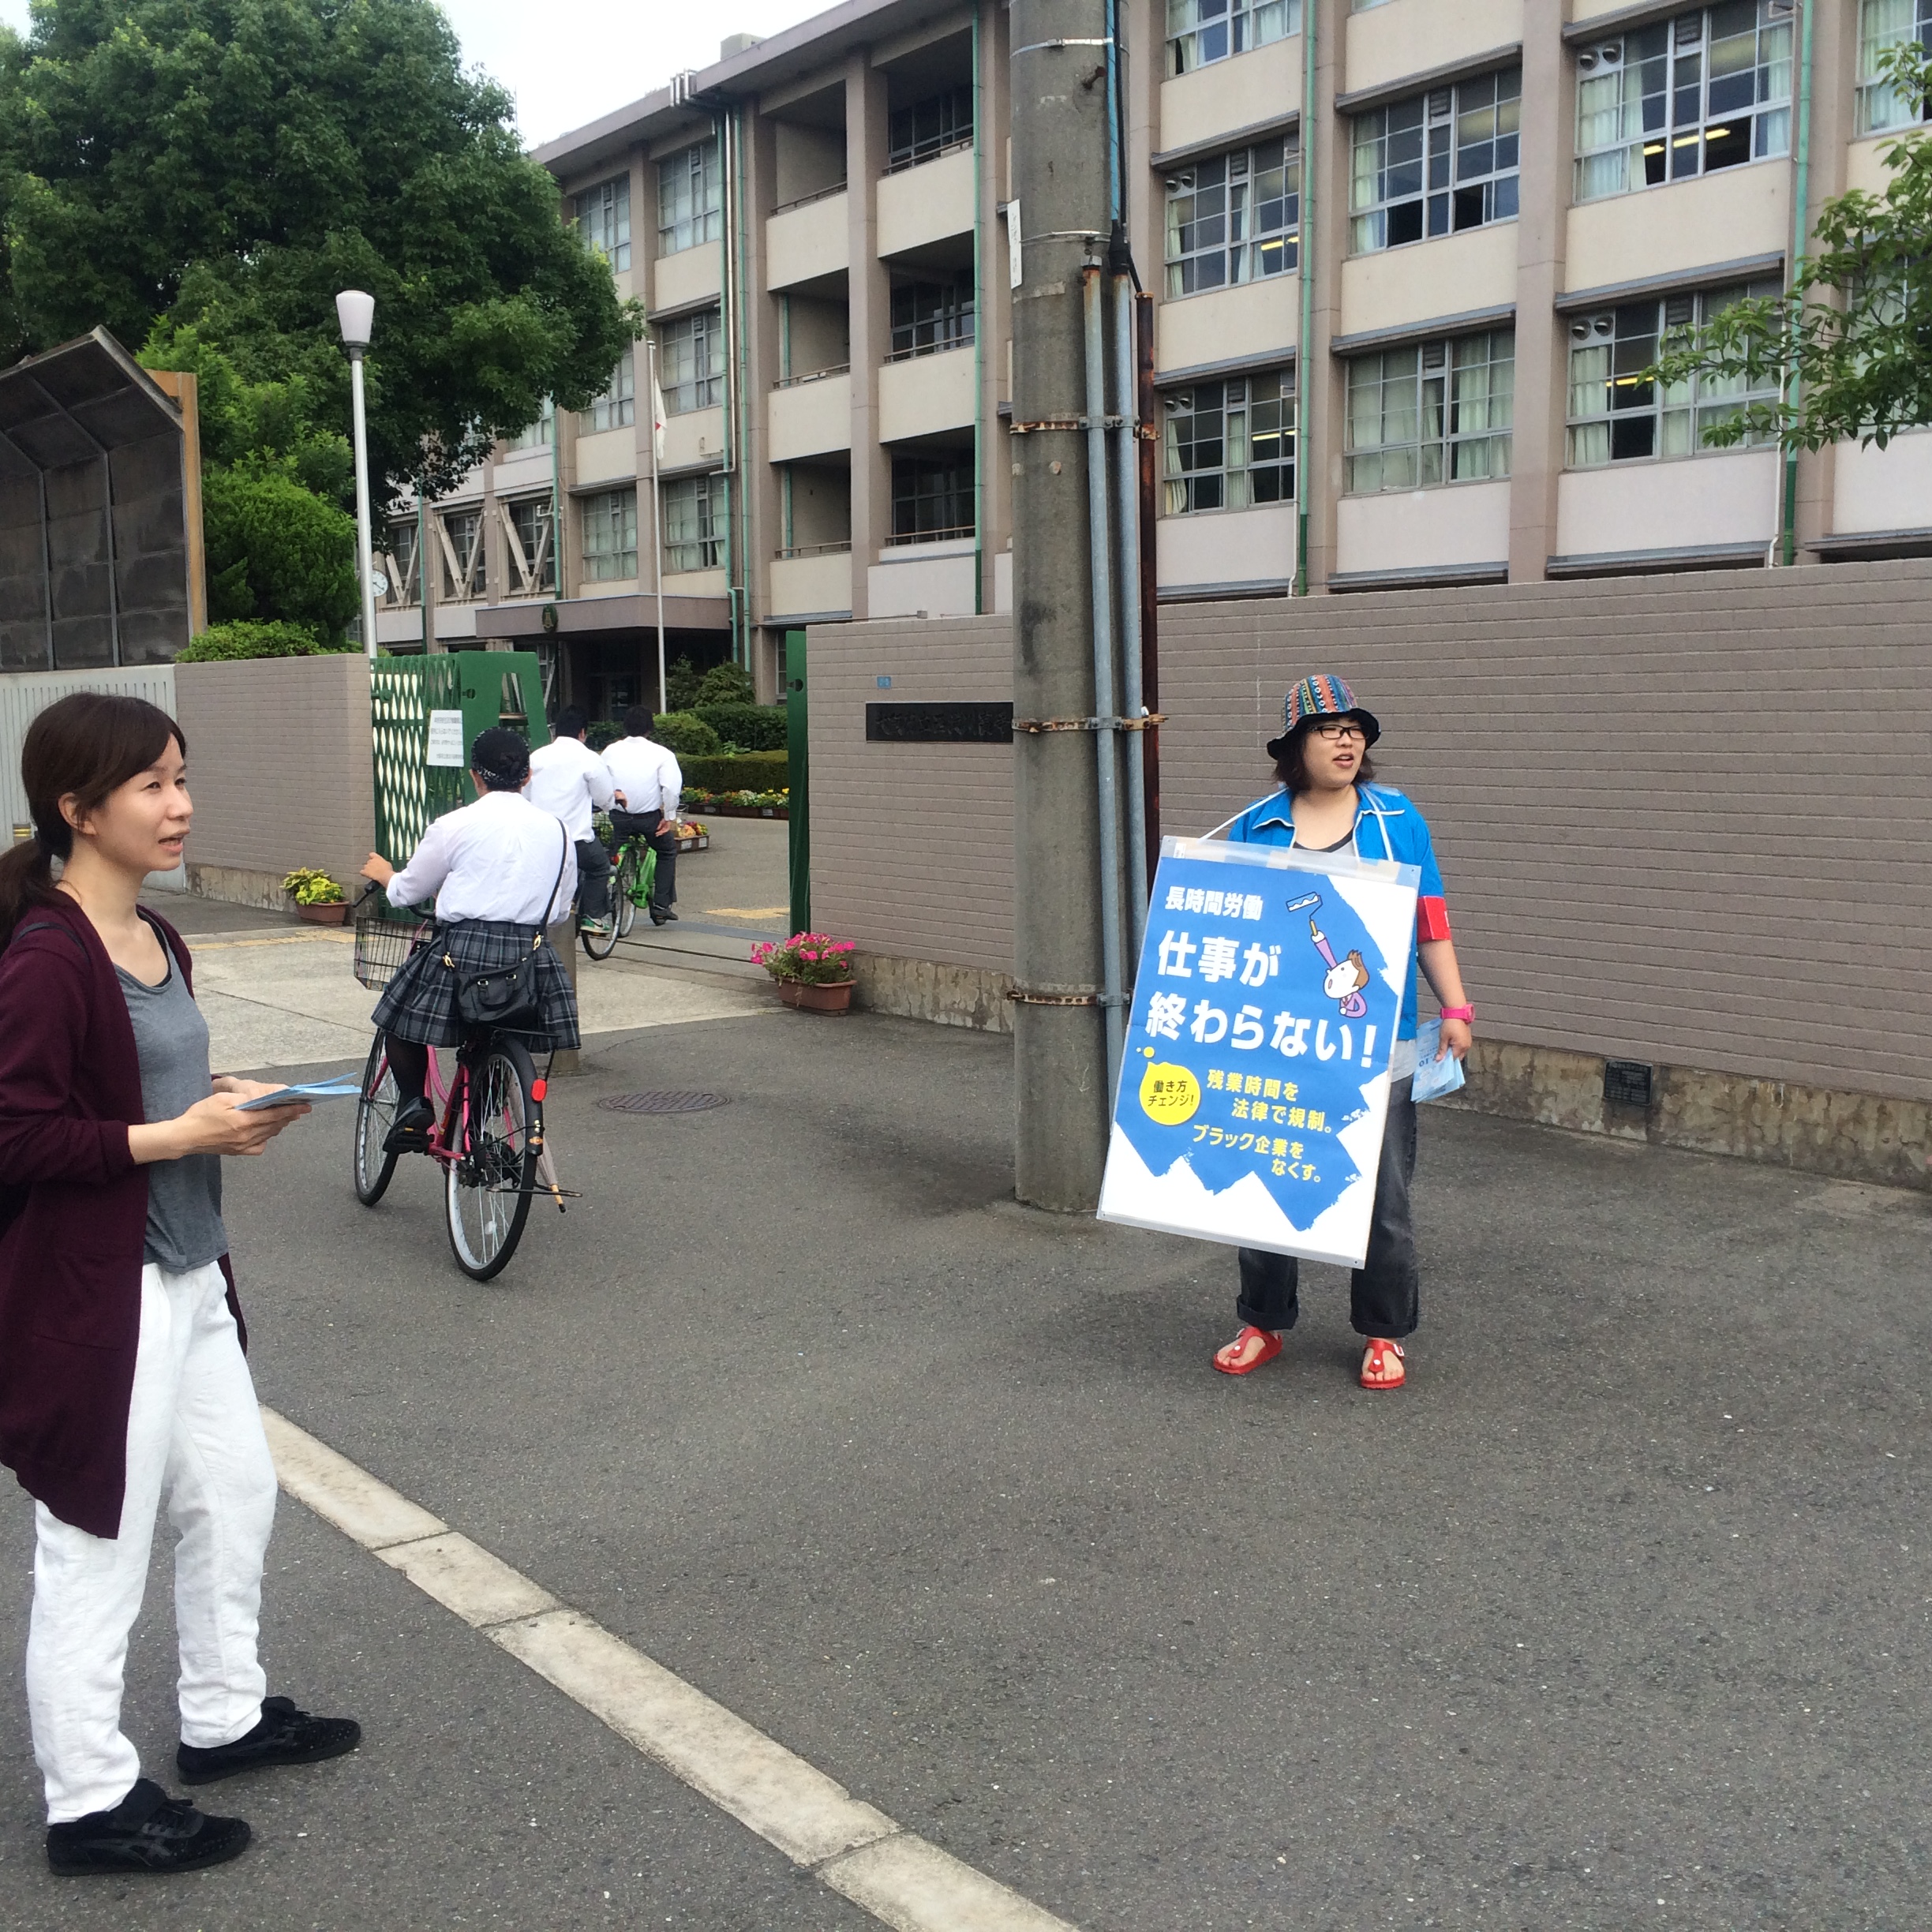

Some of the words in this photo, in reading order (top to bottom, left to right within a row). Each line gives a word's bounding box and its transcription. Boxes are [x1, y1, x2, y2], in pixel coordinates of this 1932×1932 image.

[1166, 886, 1263, 921] 長時間労働
[1157, 931, 1282, 987] 仕事が
[1145, 991, 1377, 1069] 終わらない!
[1148, 1094, 1194, 1106] チェンジ!
[1153, 1080, 1188, 1093] 働き方
[1207, 1069, 1299, 1102] 残業時間を
[1231, 1098, 1331, 1133] 法律で規制。
[1193, 1124, 1304, 1159] ブラック企業を
[1271, 1158, 1321, 1182] なくす。
